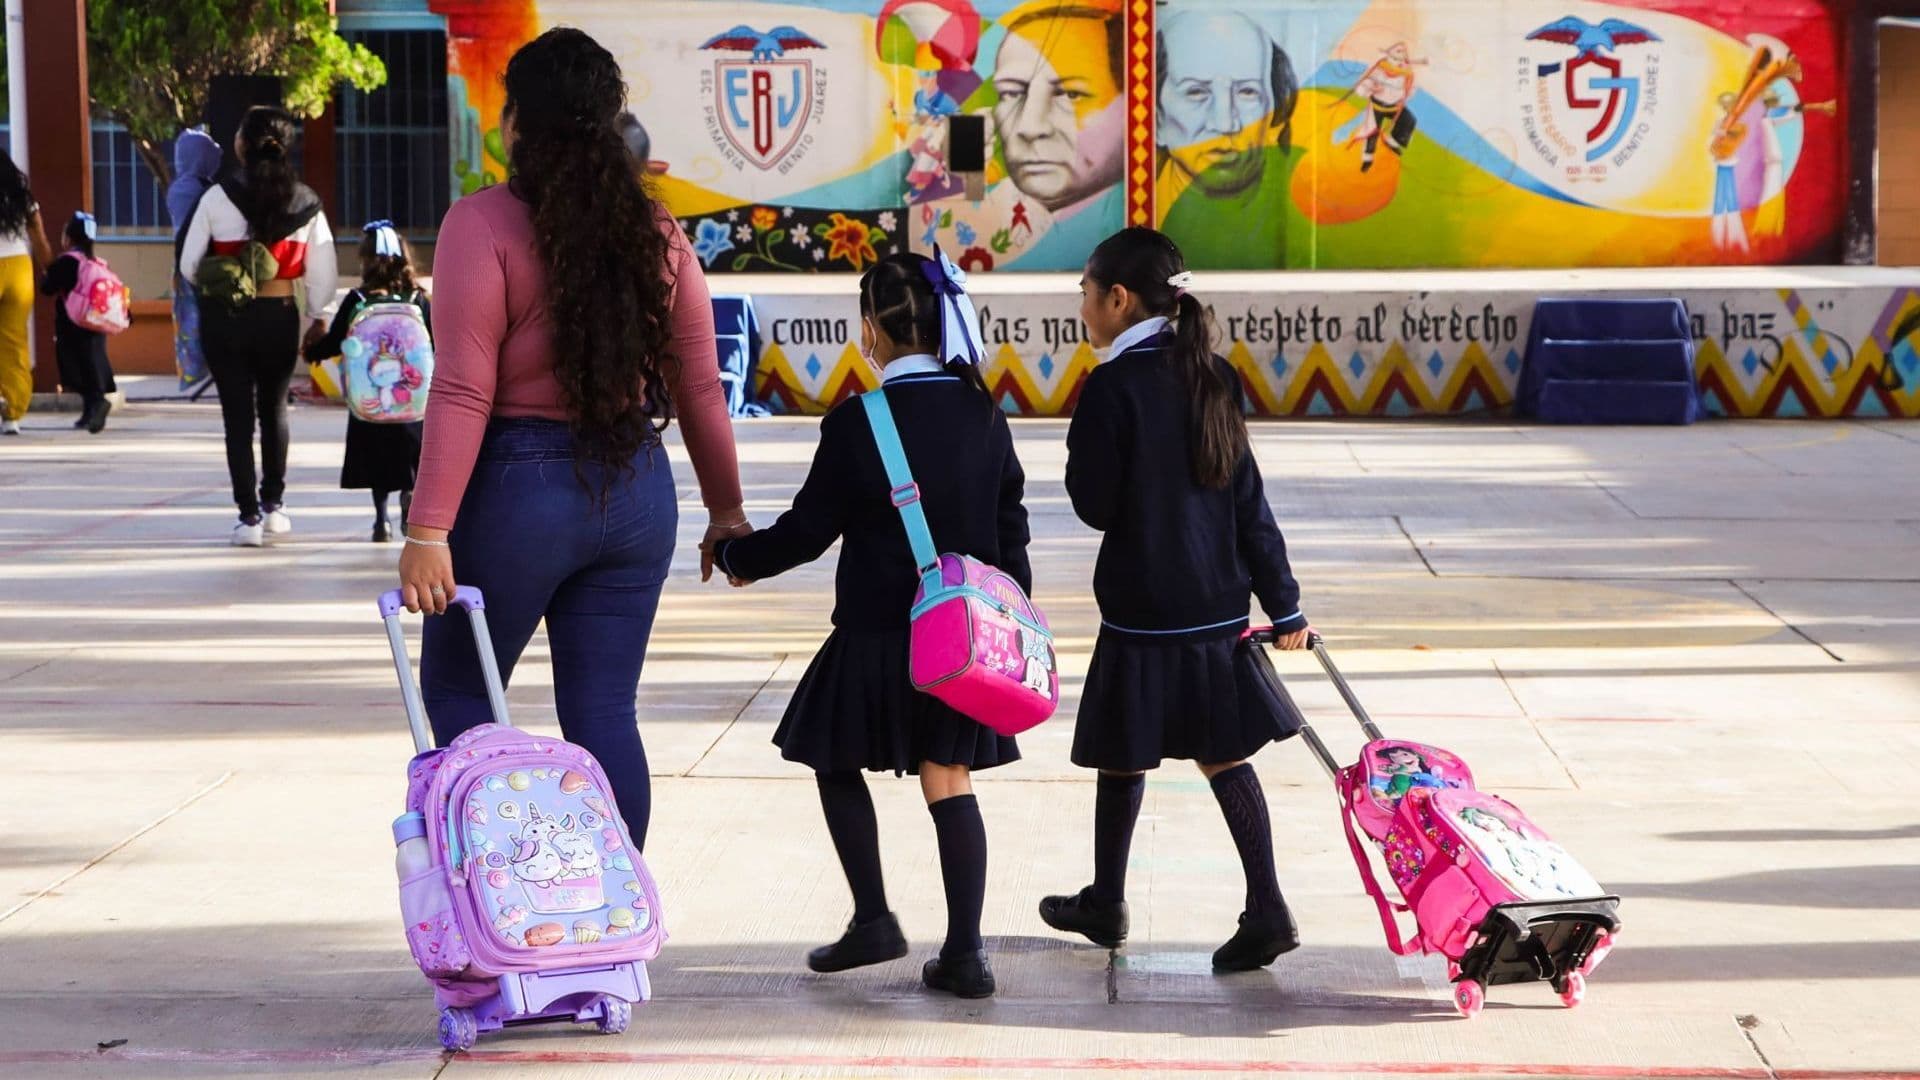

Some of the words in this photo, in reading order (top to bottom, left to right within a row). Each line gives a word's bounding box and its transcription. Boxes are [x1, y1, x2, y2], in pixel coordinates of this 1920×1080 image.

[703, 106, 745, 172] PRIMARIA
[777, 134, 814, 175] BENITO
[1520, 104, 1559, 168] PRIMARIA
[1613, 122, 1650, 168] BENITO
[772, 317, 848, 345] como
[979, 304, 1030, 344] las
[1227, 303, 1342, 355] respeto
[1355, 302, 1387, 343] al
[1401, 302, 1518, 350] derecho
[1721, 301, 1784, 375] paz
